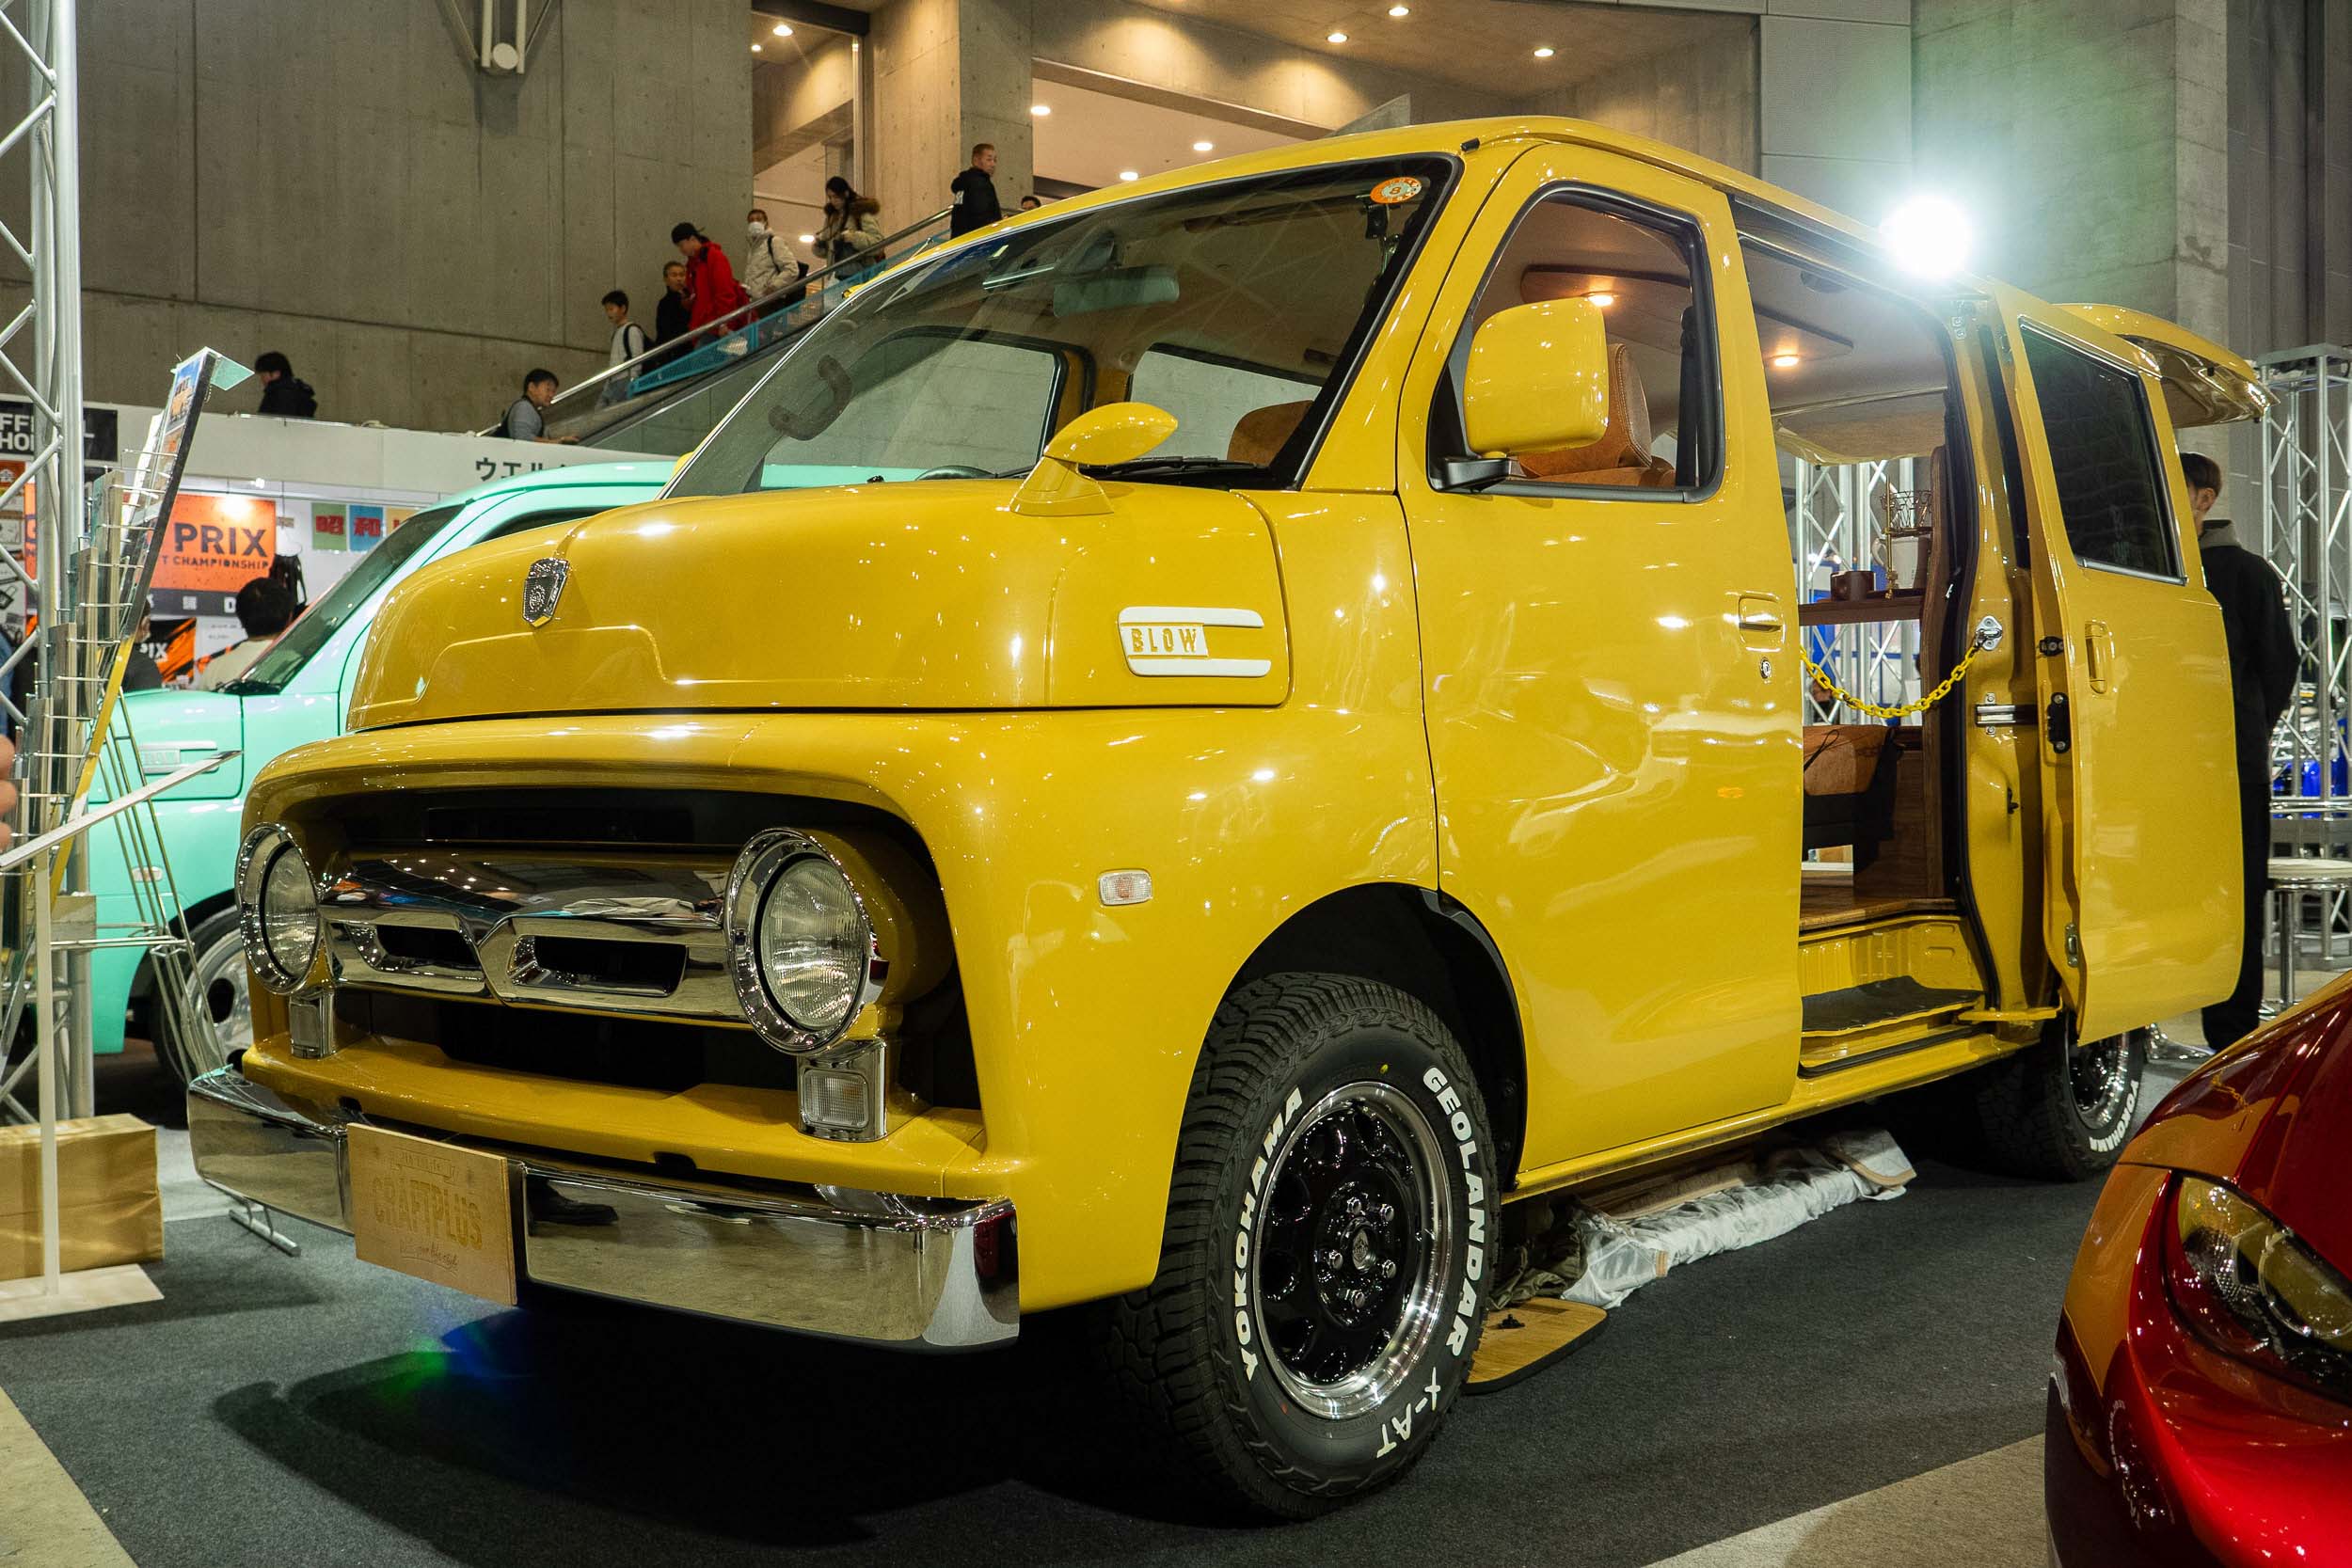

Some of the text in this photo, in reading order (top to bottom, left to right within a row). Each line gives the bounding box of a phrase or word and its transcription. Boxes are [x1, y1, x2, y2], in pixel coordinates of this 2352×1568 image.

[174, 522, 267, 558] PRIX
[315, 515, 400, 537] 昭和
[173, 555, 269, 570] CHAMPIONSHIP
[1131, 627, 1198, 653] BLOW
[2089, 1080, 2139, 1152] YOKOHAMA
[1235, 1086, 1304, 1381] YOKOHAMA
[1422, 1067, 1486, 1356] GEOLANDAR
[1376, 1367, 1441, 1458] X-AT
